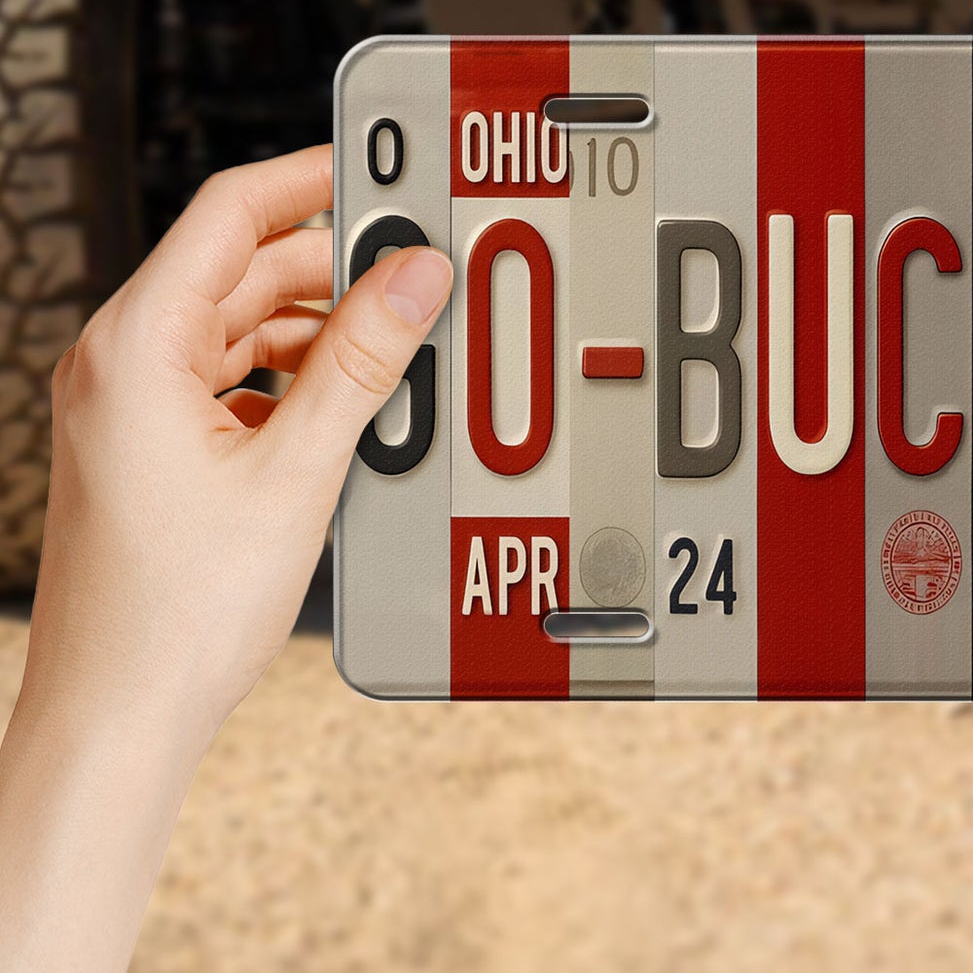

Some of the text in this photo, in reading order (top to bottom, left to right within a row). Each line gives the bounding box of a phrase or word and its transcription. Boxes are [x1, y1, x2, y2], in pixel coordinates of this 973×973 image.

[461, 111, 568, 183] OHIO
[569, 136, 640, 197] 10
[461, 536, 560, 616] APR
[667, 537, 737, 615] 24
